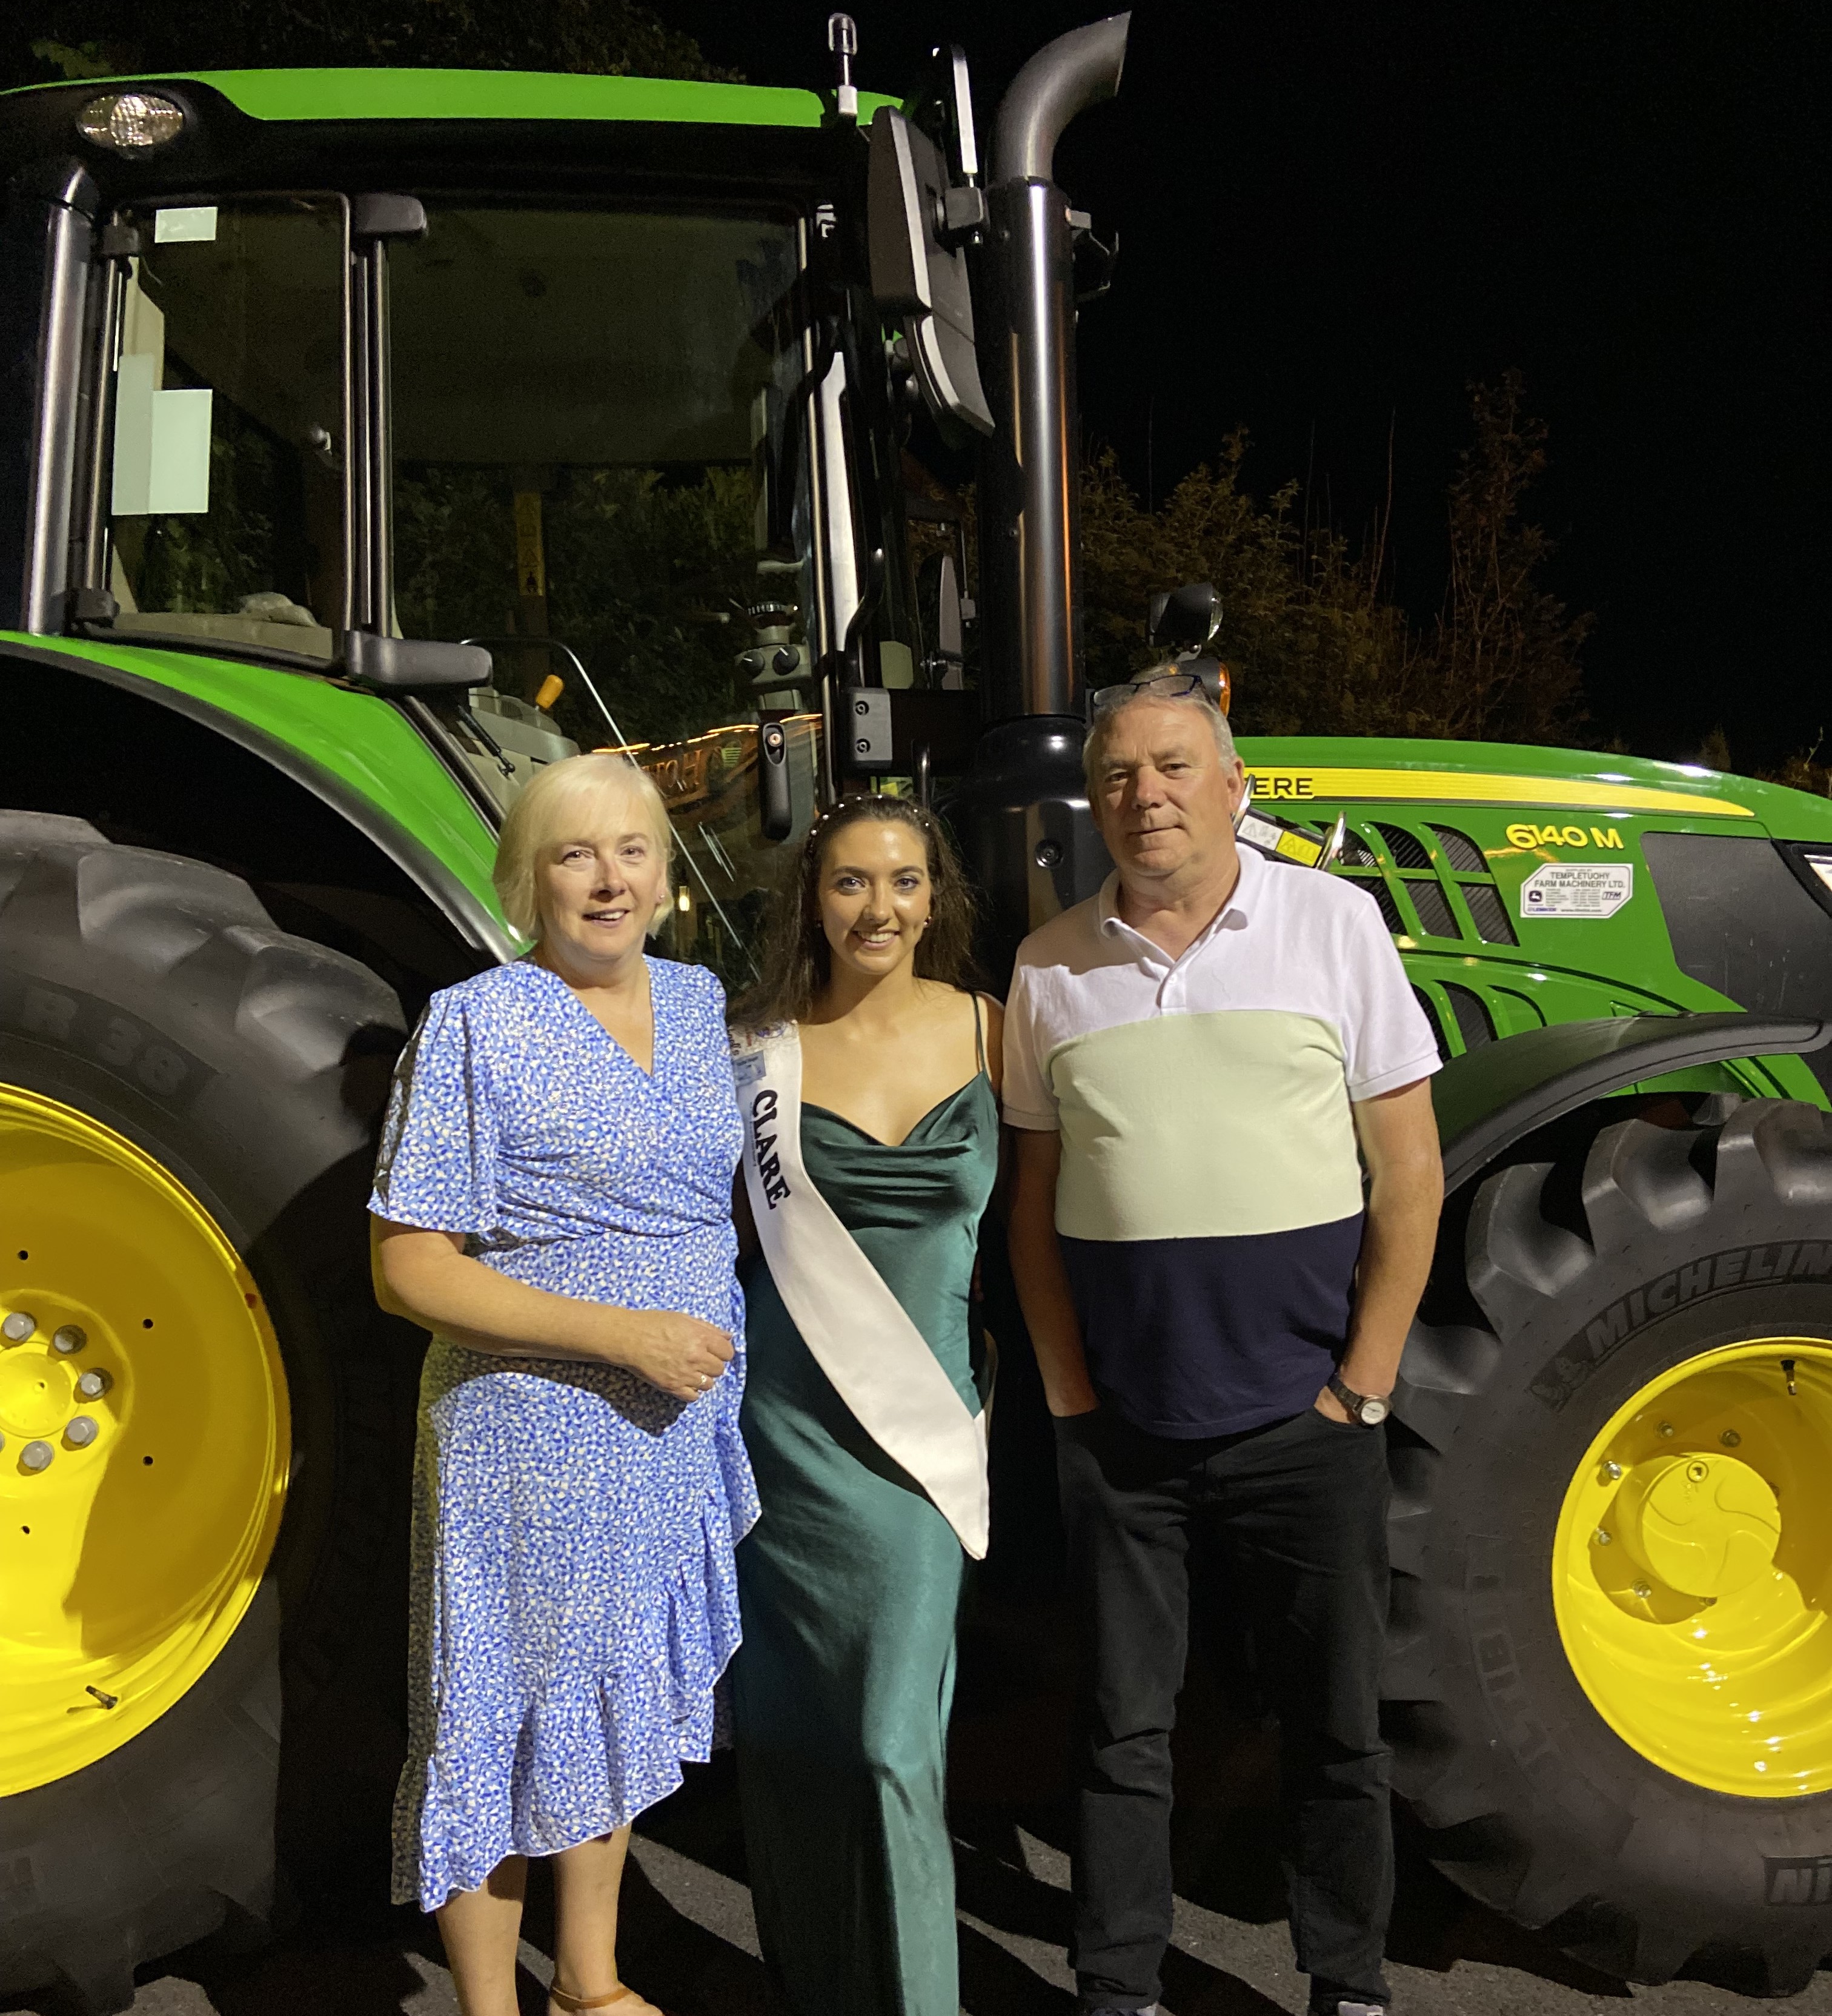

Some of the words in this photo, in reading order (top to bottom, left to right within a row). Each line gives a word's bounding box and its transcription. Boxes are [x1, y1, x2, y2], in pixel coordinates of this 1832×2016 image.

[1244, 777, 1313, 795] ERE
[1506, 824, 1588, 849] 6140
[1590, 827, 1624, 849] M
[753, 1090, 791, 1210] CLARE
[1584, 1242, 1832, 1359] MICHELIN
